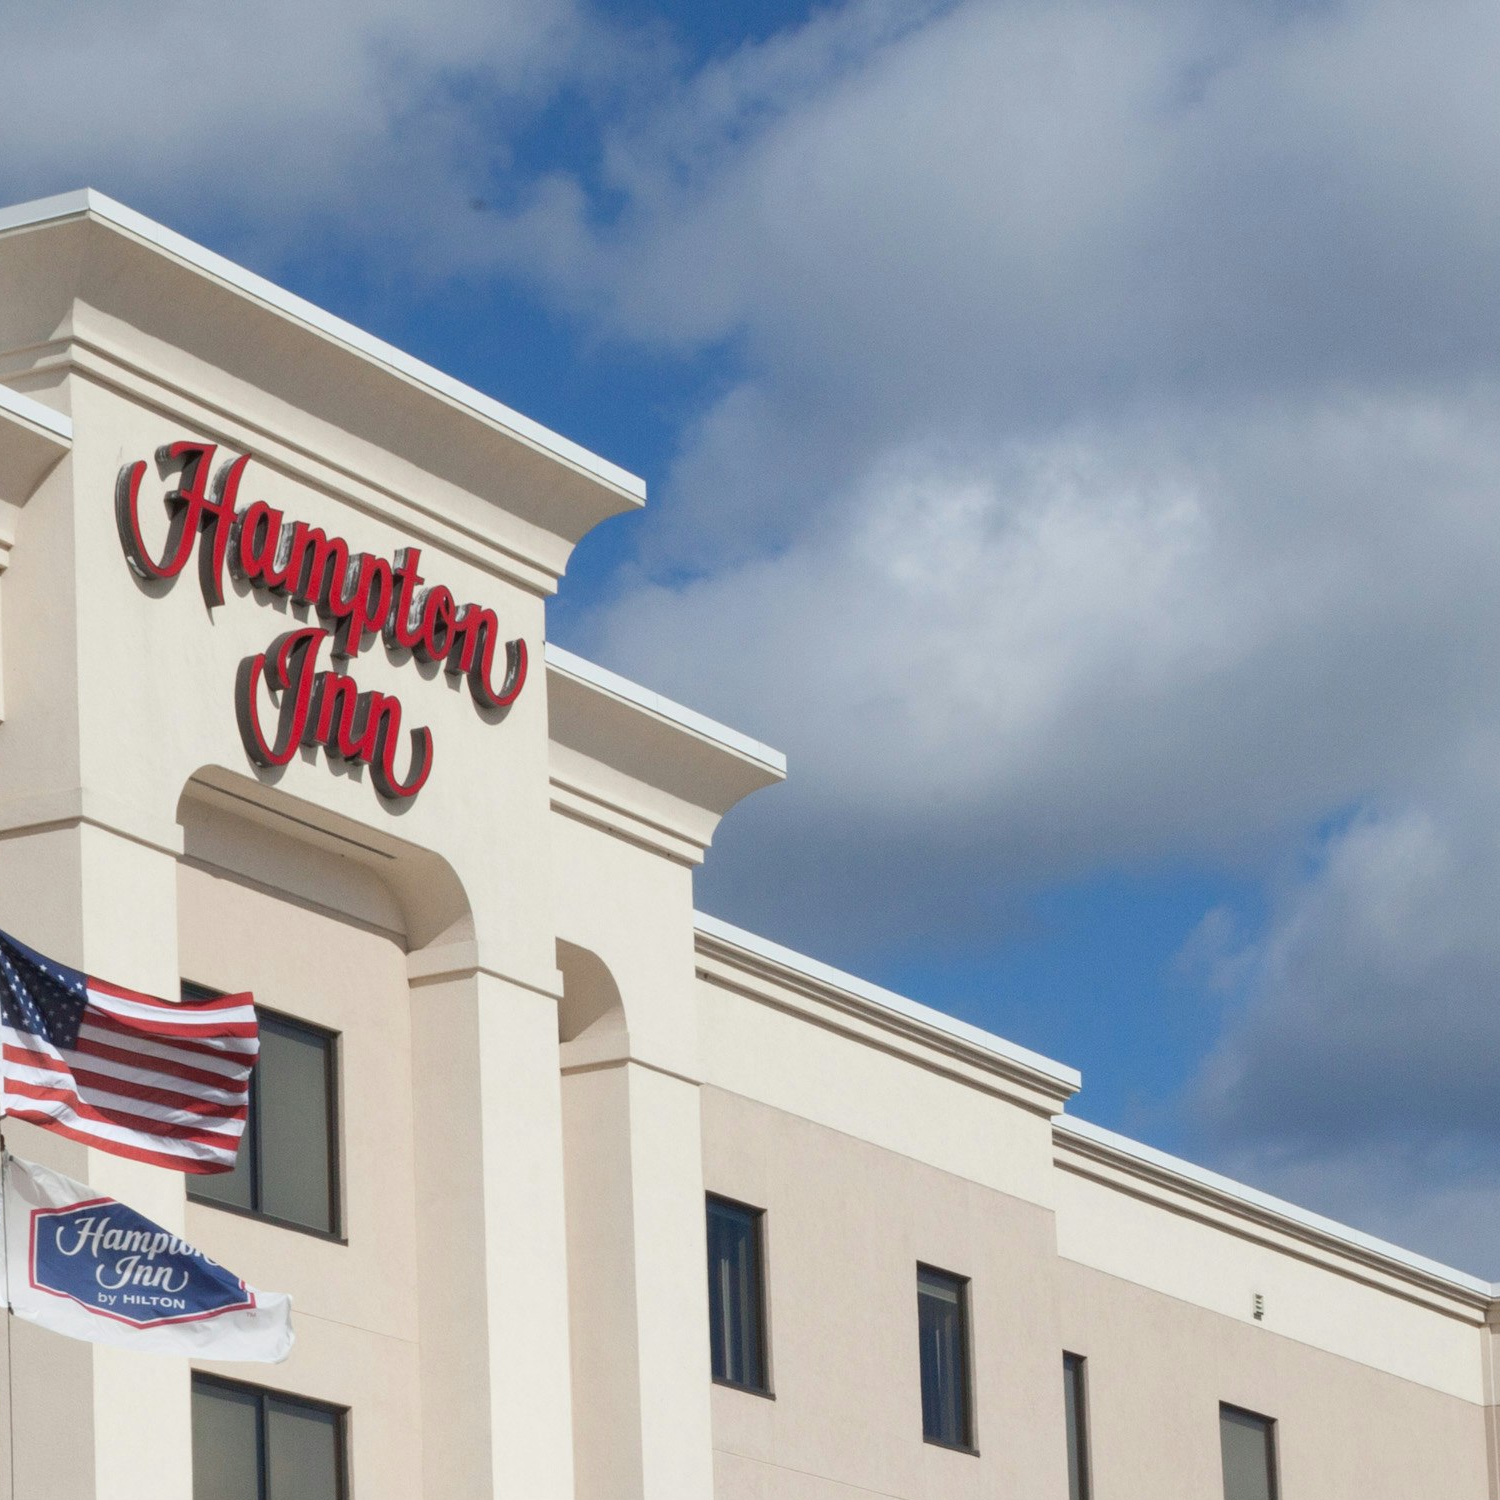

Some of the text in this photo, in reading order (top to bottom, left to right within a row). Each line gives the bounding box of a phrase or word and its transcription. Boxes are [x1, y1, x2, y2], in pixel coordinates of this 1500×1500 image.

[116, 441, 528, 708] Hampton
[235, 627, 433, 797] Inn
[96, 1255, 188, 1292] Inn
[98, 1292, 185, 1309] by HILTON
